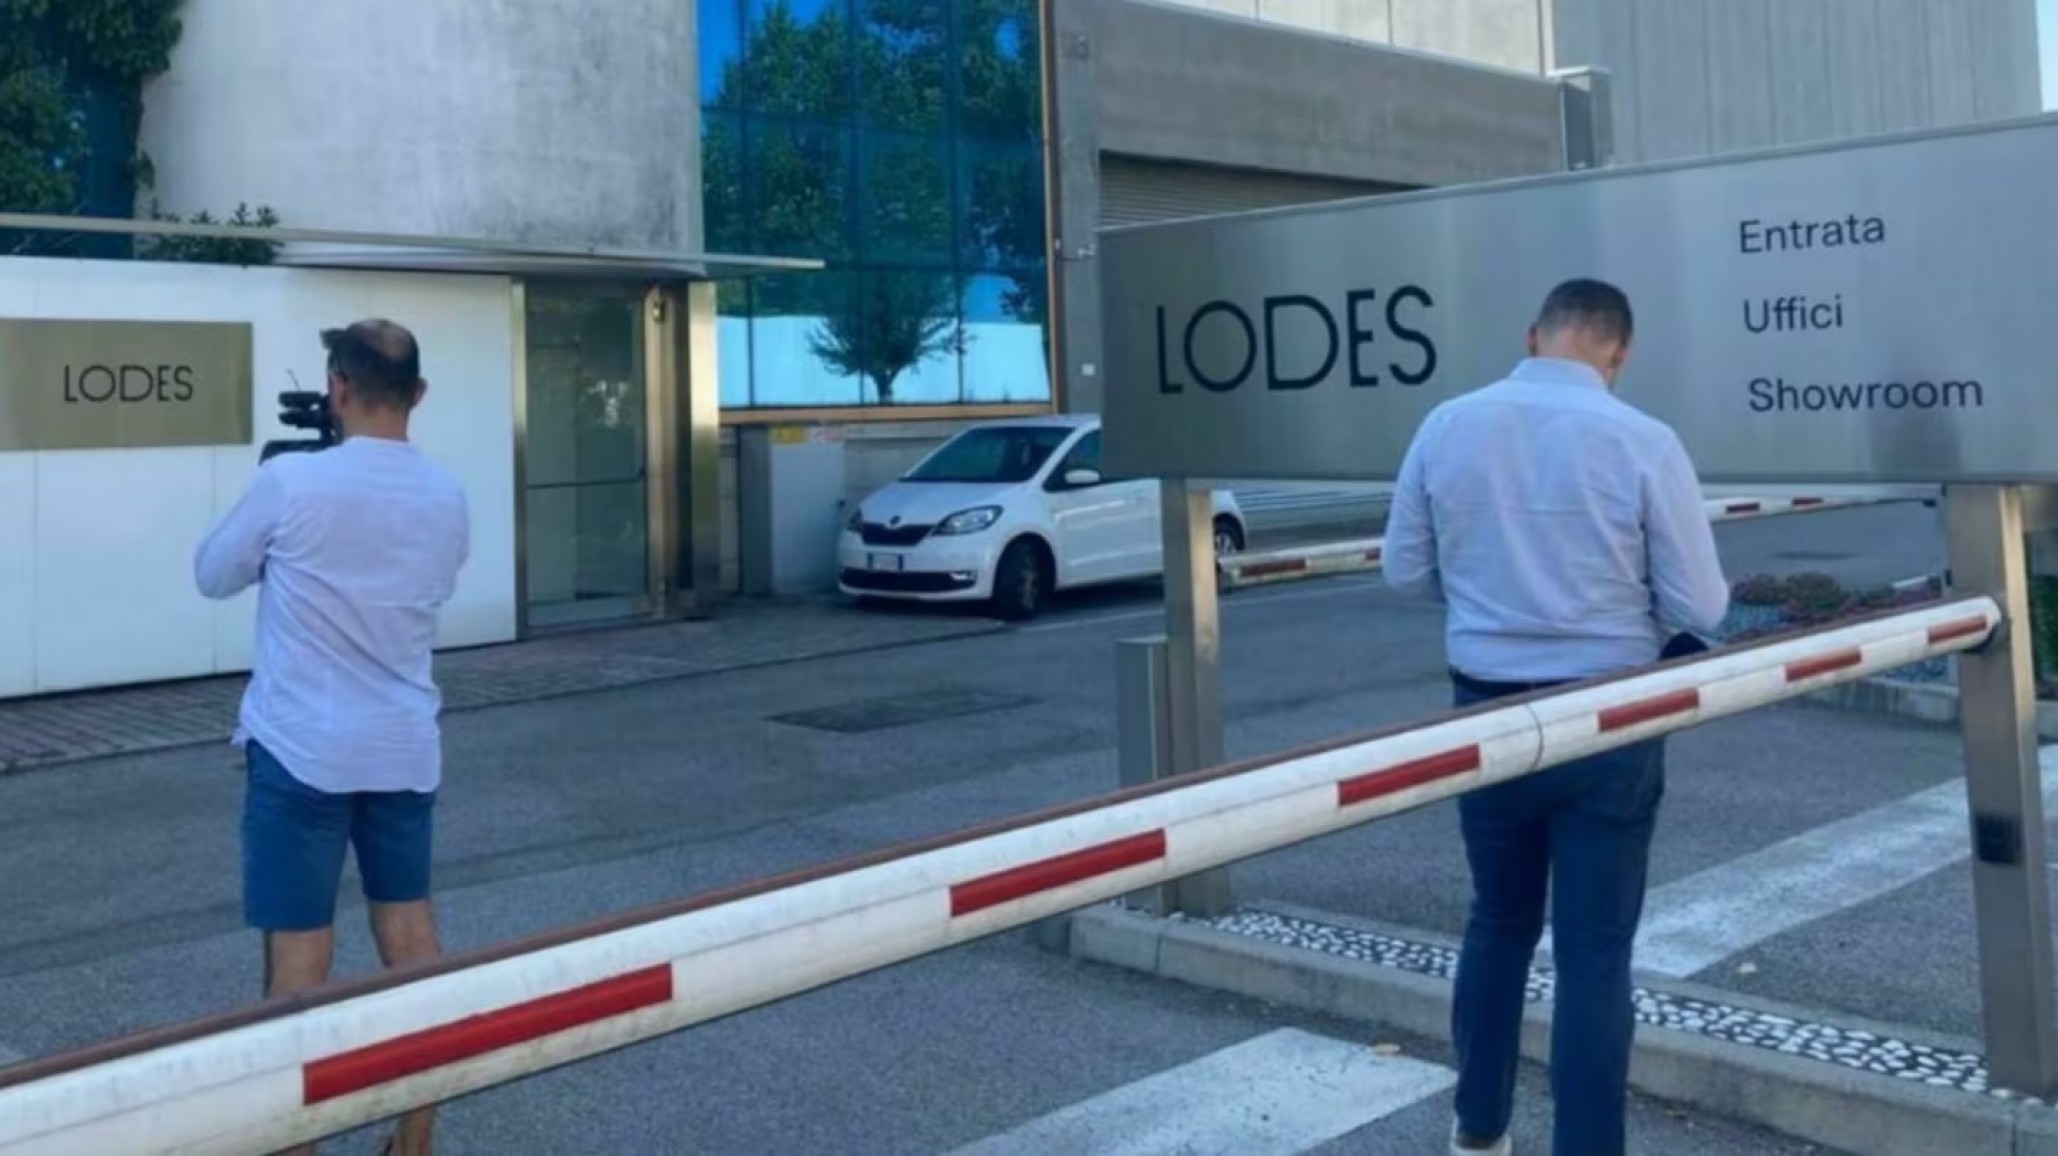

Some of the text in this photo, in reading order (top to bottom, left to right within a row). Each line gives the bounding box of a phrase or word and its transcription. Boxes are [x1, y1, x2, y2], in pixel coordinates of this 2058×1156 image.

[1739, 213, 1886, 254] Entrata
[1743, 293, 1844, 334] Uffici
[1156, 284, 1437, 395] LODES
[63, 363, 195, 404] LODES
[1748, 377, 1984, 413] Showroom
